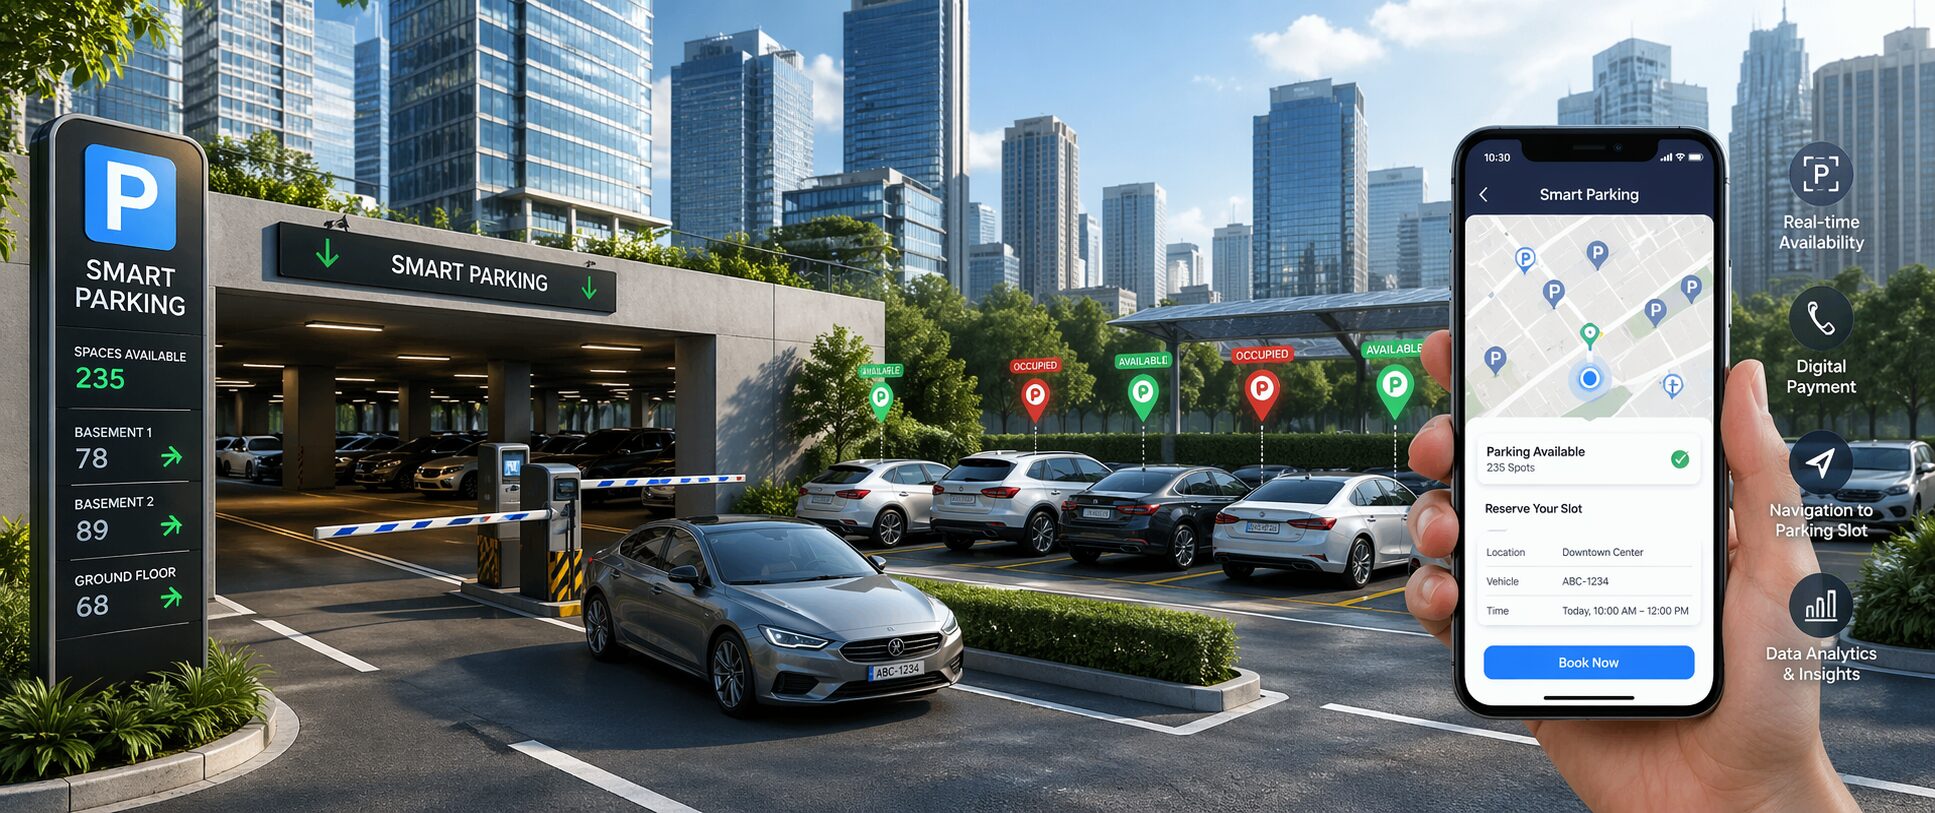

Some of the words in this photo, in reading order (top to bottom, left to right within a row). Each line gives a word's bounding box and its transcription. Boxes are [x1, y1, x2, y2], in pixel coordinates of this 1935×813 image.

[1484, 153, 1511, 163] 10:30
[107, 160, 158, 231] P
[1540, 188, 1583, 202] Smart
[1586, 187, 1640, 204] Parking
[1521, 253, 1531, 265] P
[1592, 246, 1604, 259] P
[85, 258, 176, 288] SMART
[391, 254, 465, 282] SMART
[469, 265, 549, 293] PARKING
[1549, 284, 1562, 298] P
[1687, 280, 1698, 293] P
[75, 286, 187, 317] PARKING
[1651, 303, 1662, 317] P
[74, 346, 122, 360] SPACES
[125, 348, 187, 363] AVAILABLE
[1491, 351, 1502, 365] P
[76, 366, 125, 389] 235
[74, 427, 144, 438] BASEMENT
[147, 427, 152, 438] 1
[76, 448, 108, 469] 78
[1486, 446, 1531, 460] Parking
[1533, 446, 1585, 457] Available
[1486, 463, 1506, 472] 235
[1508, 463, 1535, 474] Spots
[75, 497, 143, 510] BASEMENT
[147, 496, 154, 507] 2
[1485, 503, 1530, 514] Reserve
[1533, 503, 1558, 514] Your
[1561, 503, 1583, 514] Slot
[76, 519, 109, 542] 89
[1486, 548, 1526, 557] Location
[1562, 548, 1611, 557] Downtown
[1613, 548, 1644, 557] Center
[74, 570, 132, 587] GROUND
[136, 567, 176, 582] FLOOR
[1486, 577, 1519, 586] Vehicle
[1562, 577, 1609, 586] ABC-1234
[76, 595, 109, 618] 68
[1486, 606, 1509, 616] Time
[1562, 606, 1591, 618] Today,
[1594, 606, 1619, 616] 10:00
[1621, 606, 1637, 616] AM
[1648, 606, 1672, 616] 12:00
[1674, 606, 1689, 616] PM
[1558, 657, 1589, 669] Book
[1592, 657, 1619, 669] Now
[876, 664, 919, 678] ABC-1234
